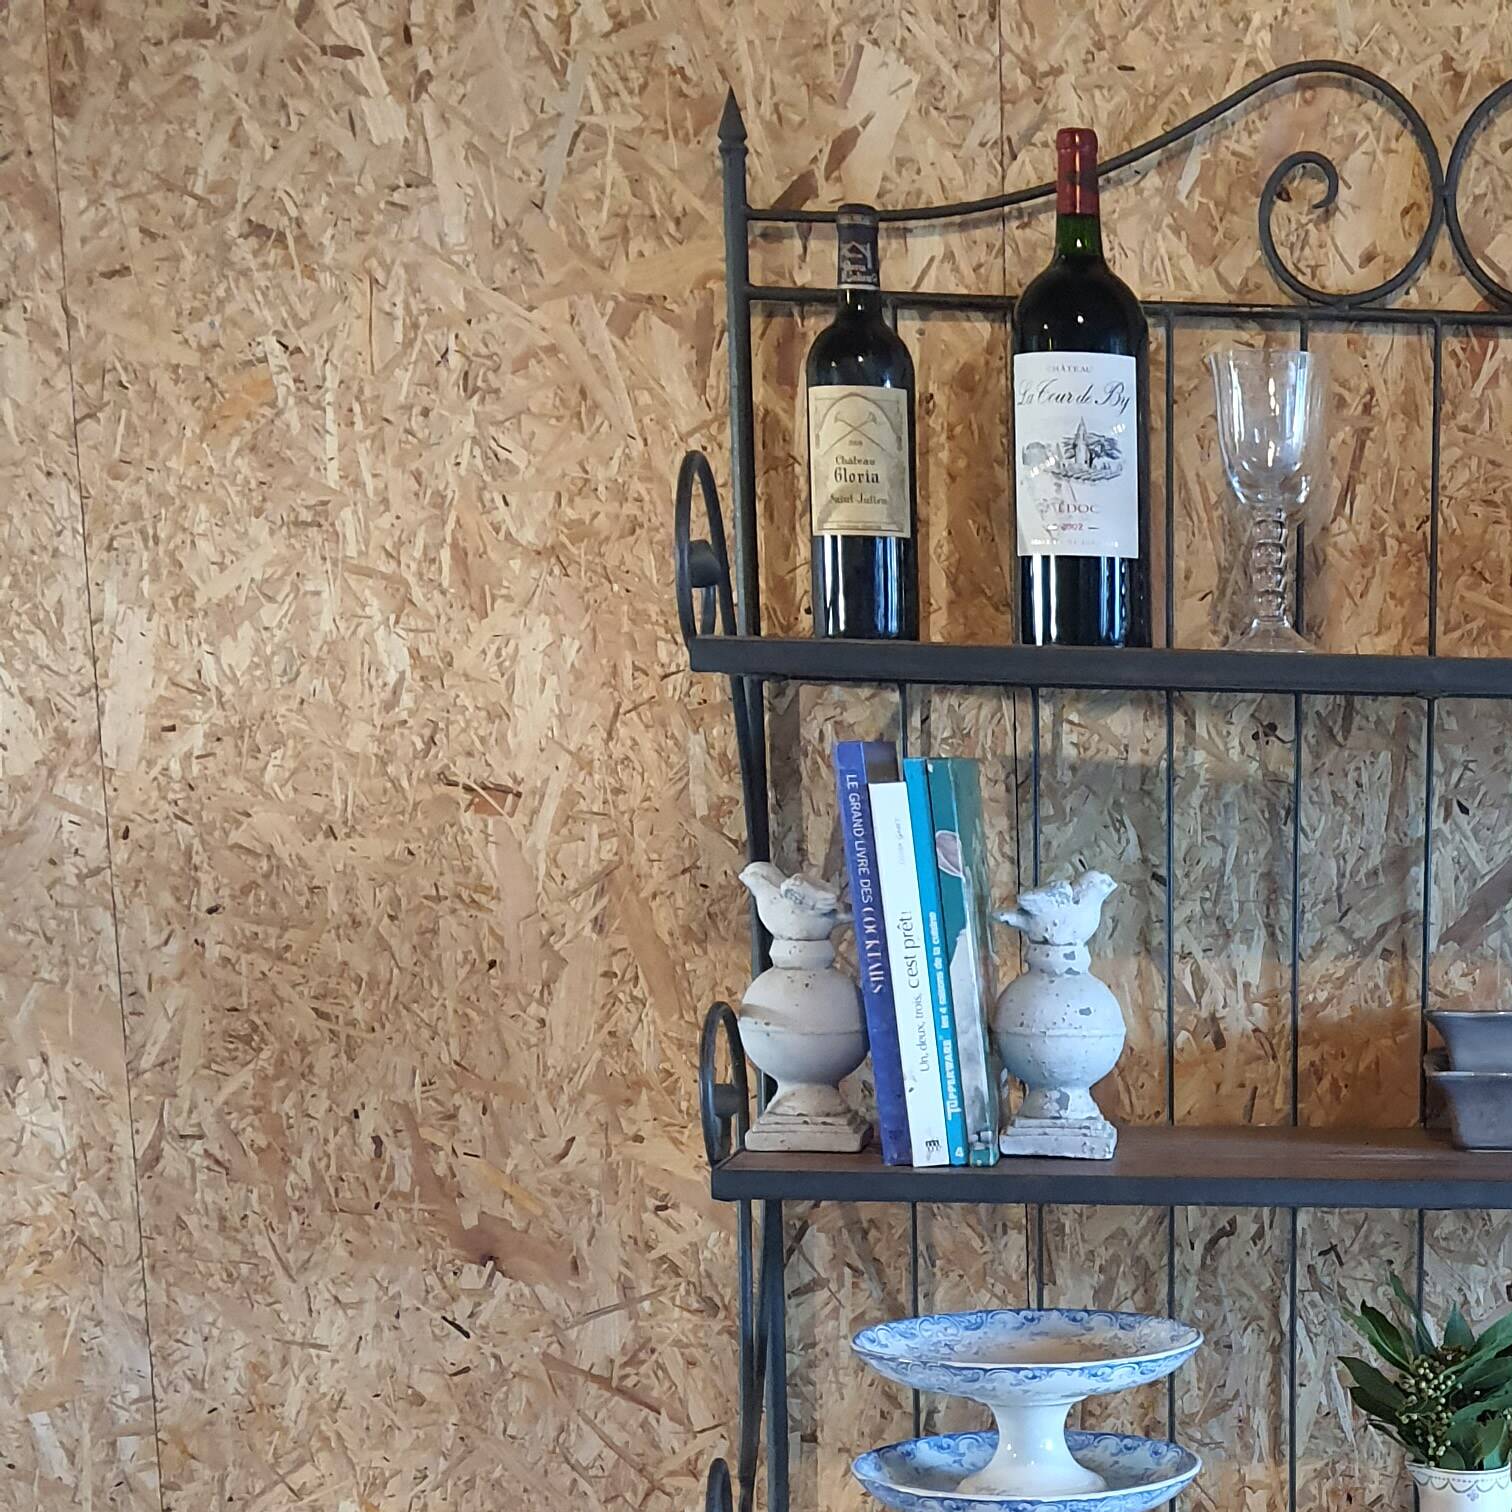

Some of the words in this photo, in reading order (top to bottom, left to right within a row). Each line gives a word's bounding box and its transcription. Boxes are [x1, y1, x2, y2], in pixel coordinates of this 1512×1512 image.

[1017, 379, 1034, 406] La
[1076, 384, 1092, 404] de
[1094, 380, 1131, 416] By
[834, 466, 880, 484] Gloria
[846, 774, 859, 790] LE
[848, 792, 865, 837] GRAND
[854, 840, 870, 876] LIVRE
[860, 879, 873, 904] DES
[862, 907, 885, 993] COCKTAILS
[916, 1021, 927, 1051] deux,
[920, 1053, 930, 1072] Un,
[942, 1039, 962, 1121] TUPPERWARE
[955, 1146, 964, 1158] 4
